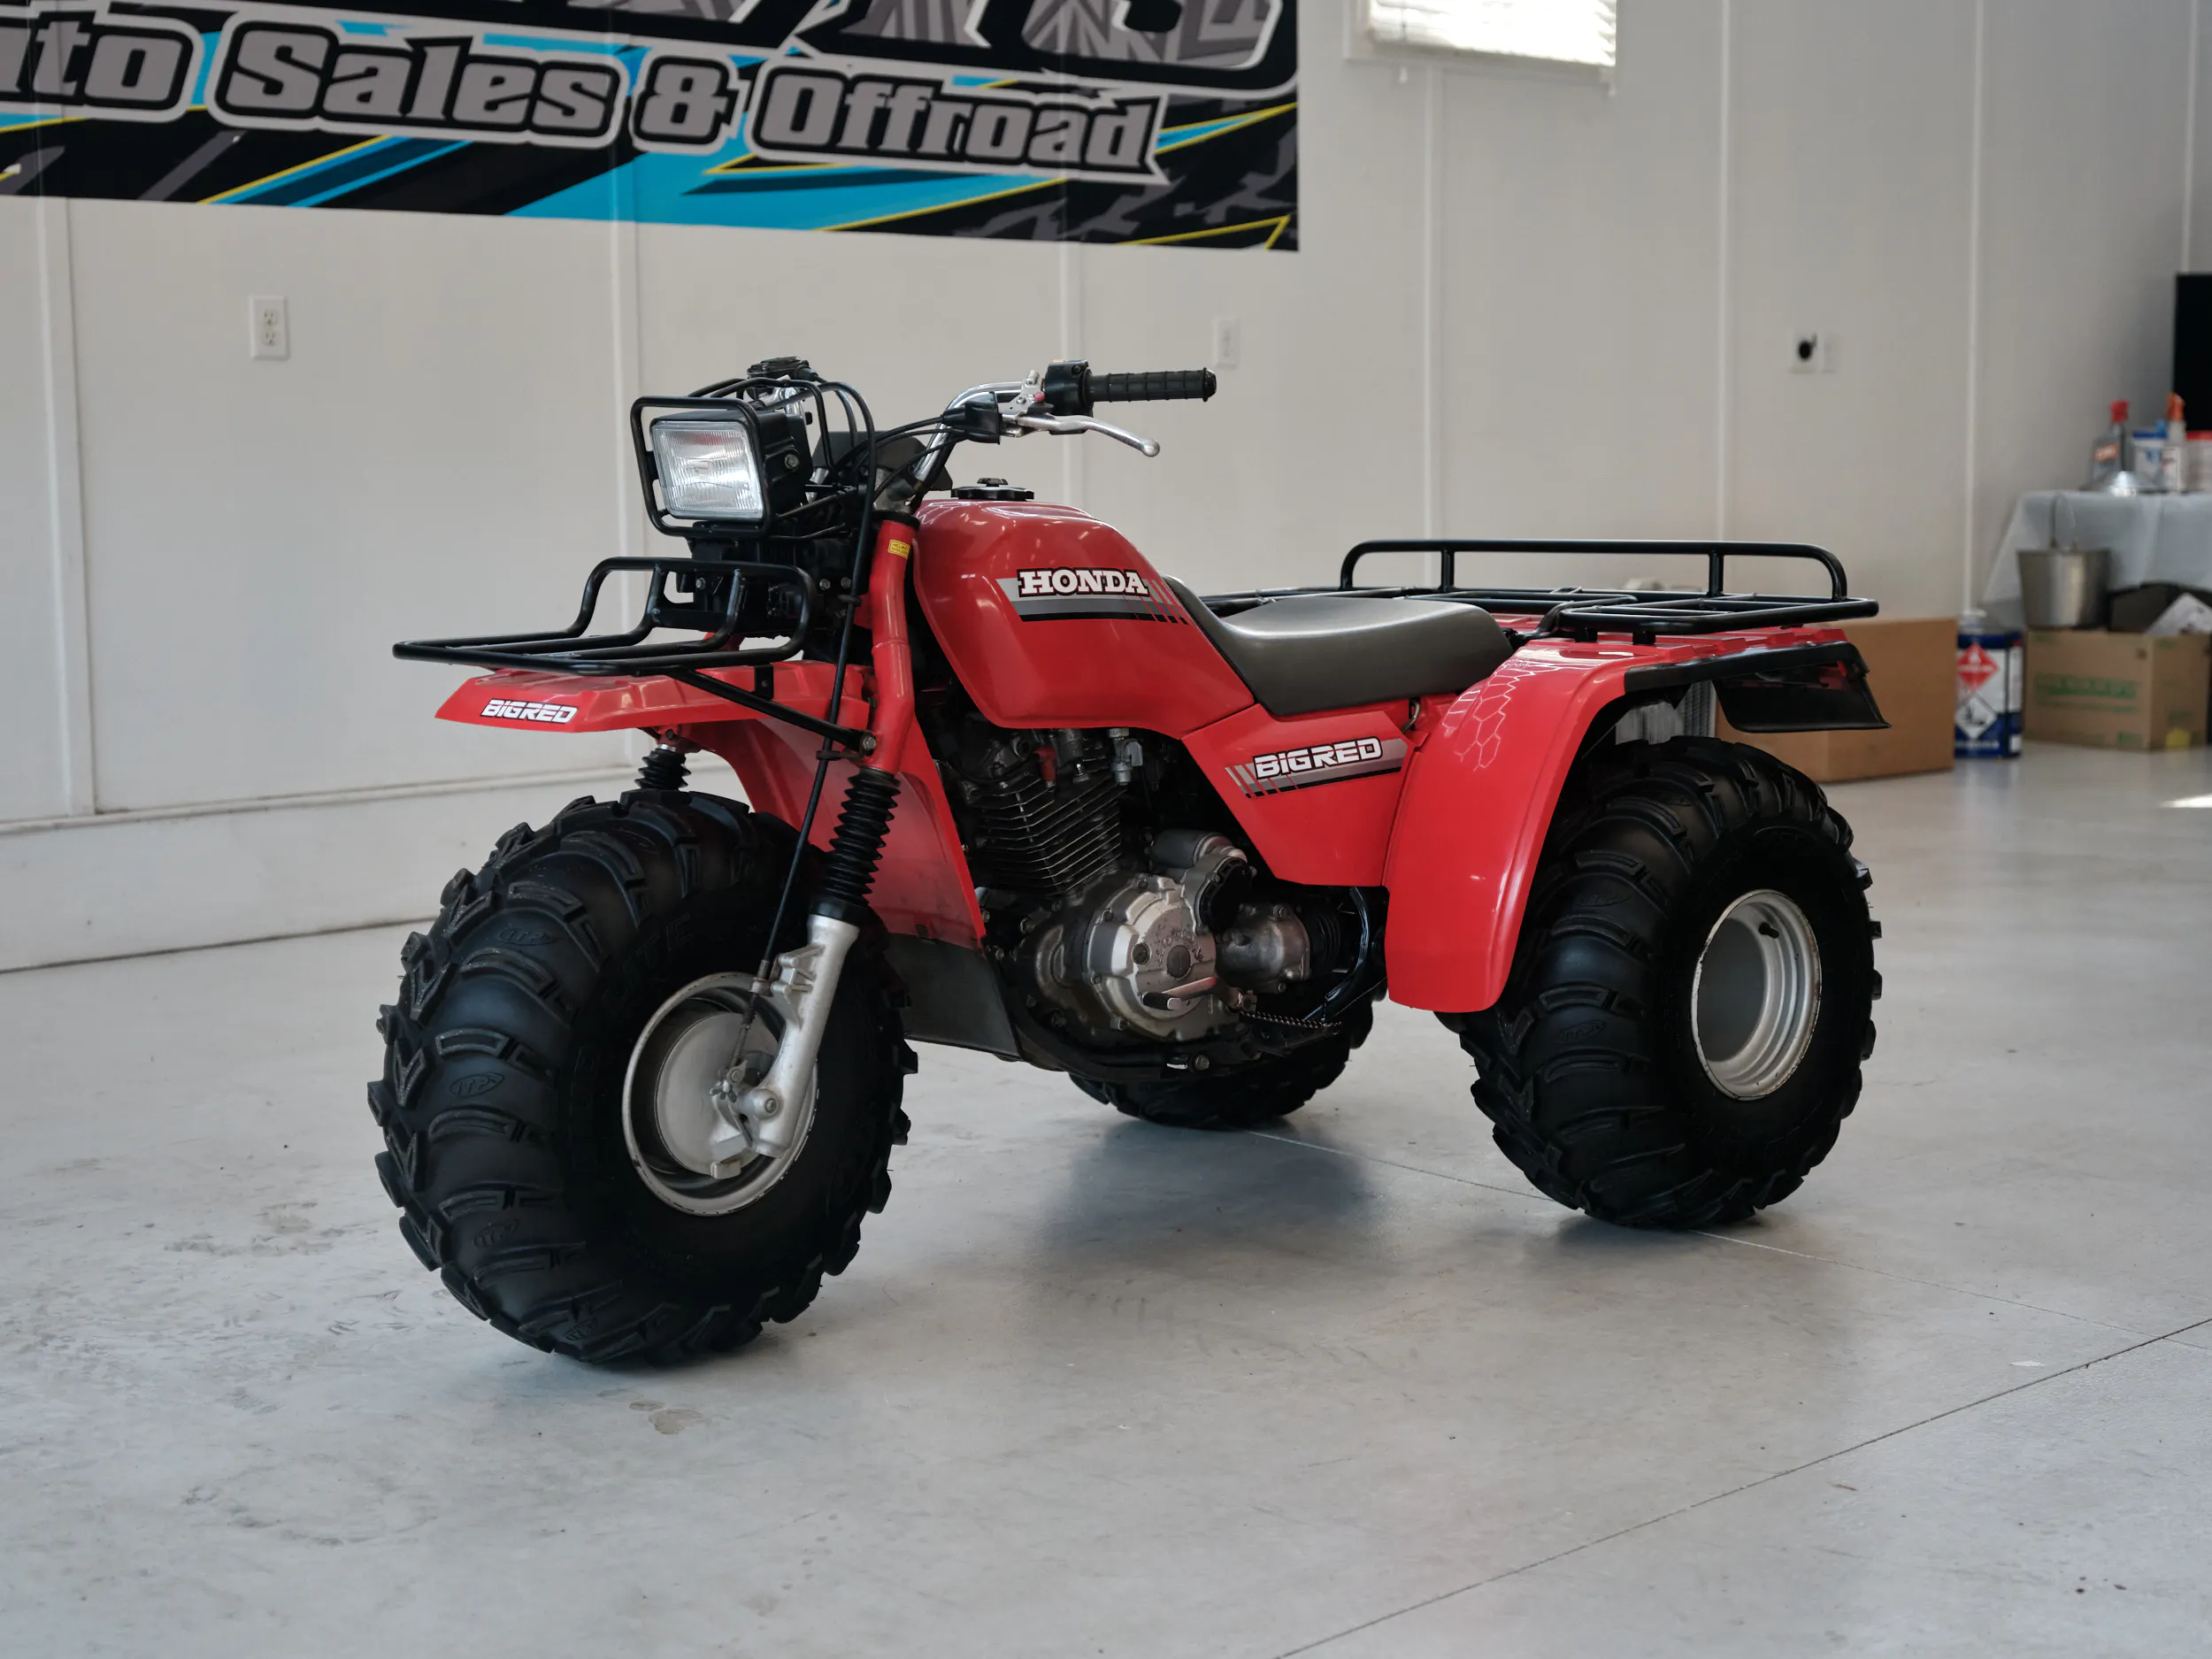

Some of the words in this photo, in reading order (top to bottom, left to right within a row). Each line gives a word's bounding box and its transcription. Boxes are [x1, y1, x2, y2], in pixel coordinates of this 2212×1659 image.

[223, 27, 615, 134] Sales
[639, 60, 731, 142] &
[758, 73, 1157, 169] Offroad
[1018, 567, 1149, 596] HONDA
